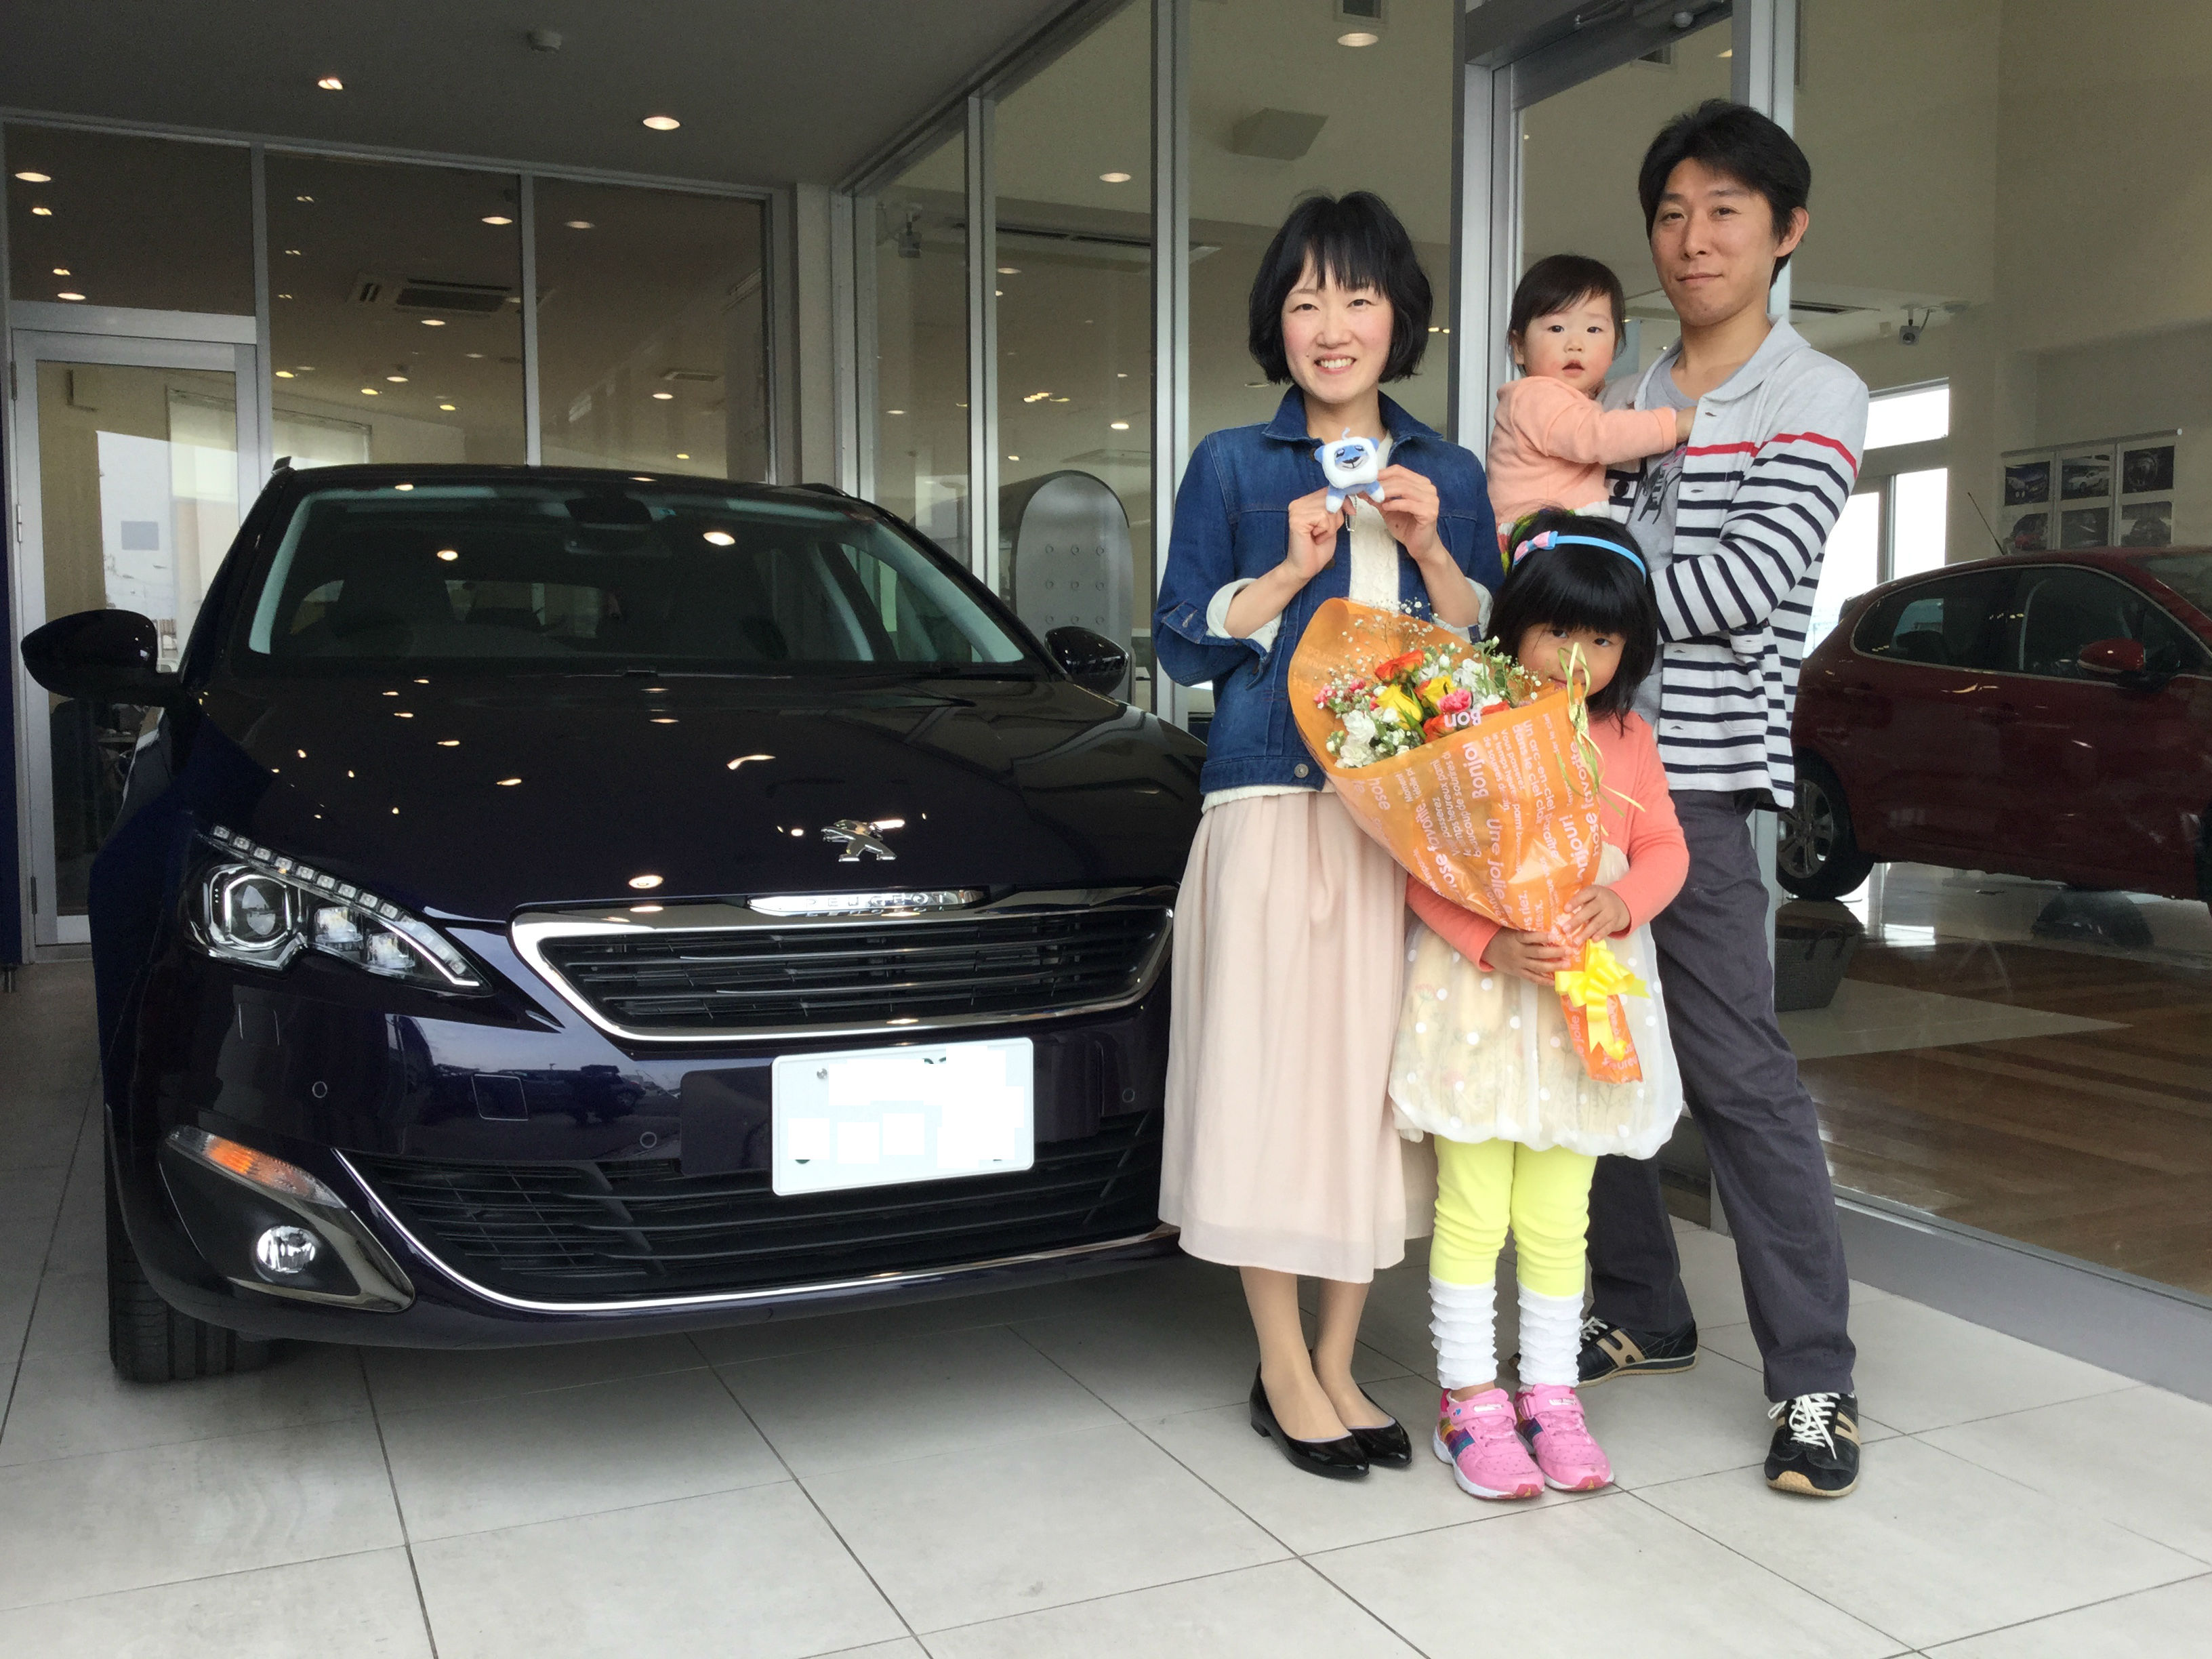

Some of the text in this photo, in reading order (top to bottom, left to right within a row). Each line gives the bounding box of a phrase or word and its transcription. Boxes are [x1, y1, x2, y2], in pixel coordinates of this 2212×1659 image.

[1430, 758, 1448, 782] parmi
[1446, 760, 1462, 797] sourires
[1500, 729, 1526, 791] Vous passerez
[1512, 724, 1529, 756] dans
[1523, 757, 1533, 770] le
[1528, 773, 1542, 798] ciel
[1523, 720, 1534, 737] Un
[1529, 739, 1557, 811] arc-en-ciel
[1395, 771, 1413, 802] Moment
[1441, 782, 1456, 821] heureux
[1455, 798, 1466, 811] de
[1433, 797, 1452, 838] passerez
[1512, 804, 1524, 830] parmi
[1486, 819, 1507, 900] Une jolie
[806, 892, 947, 907] PEUGEOT
